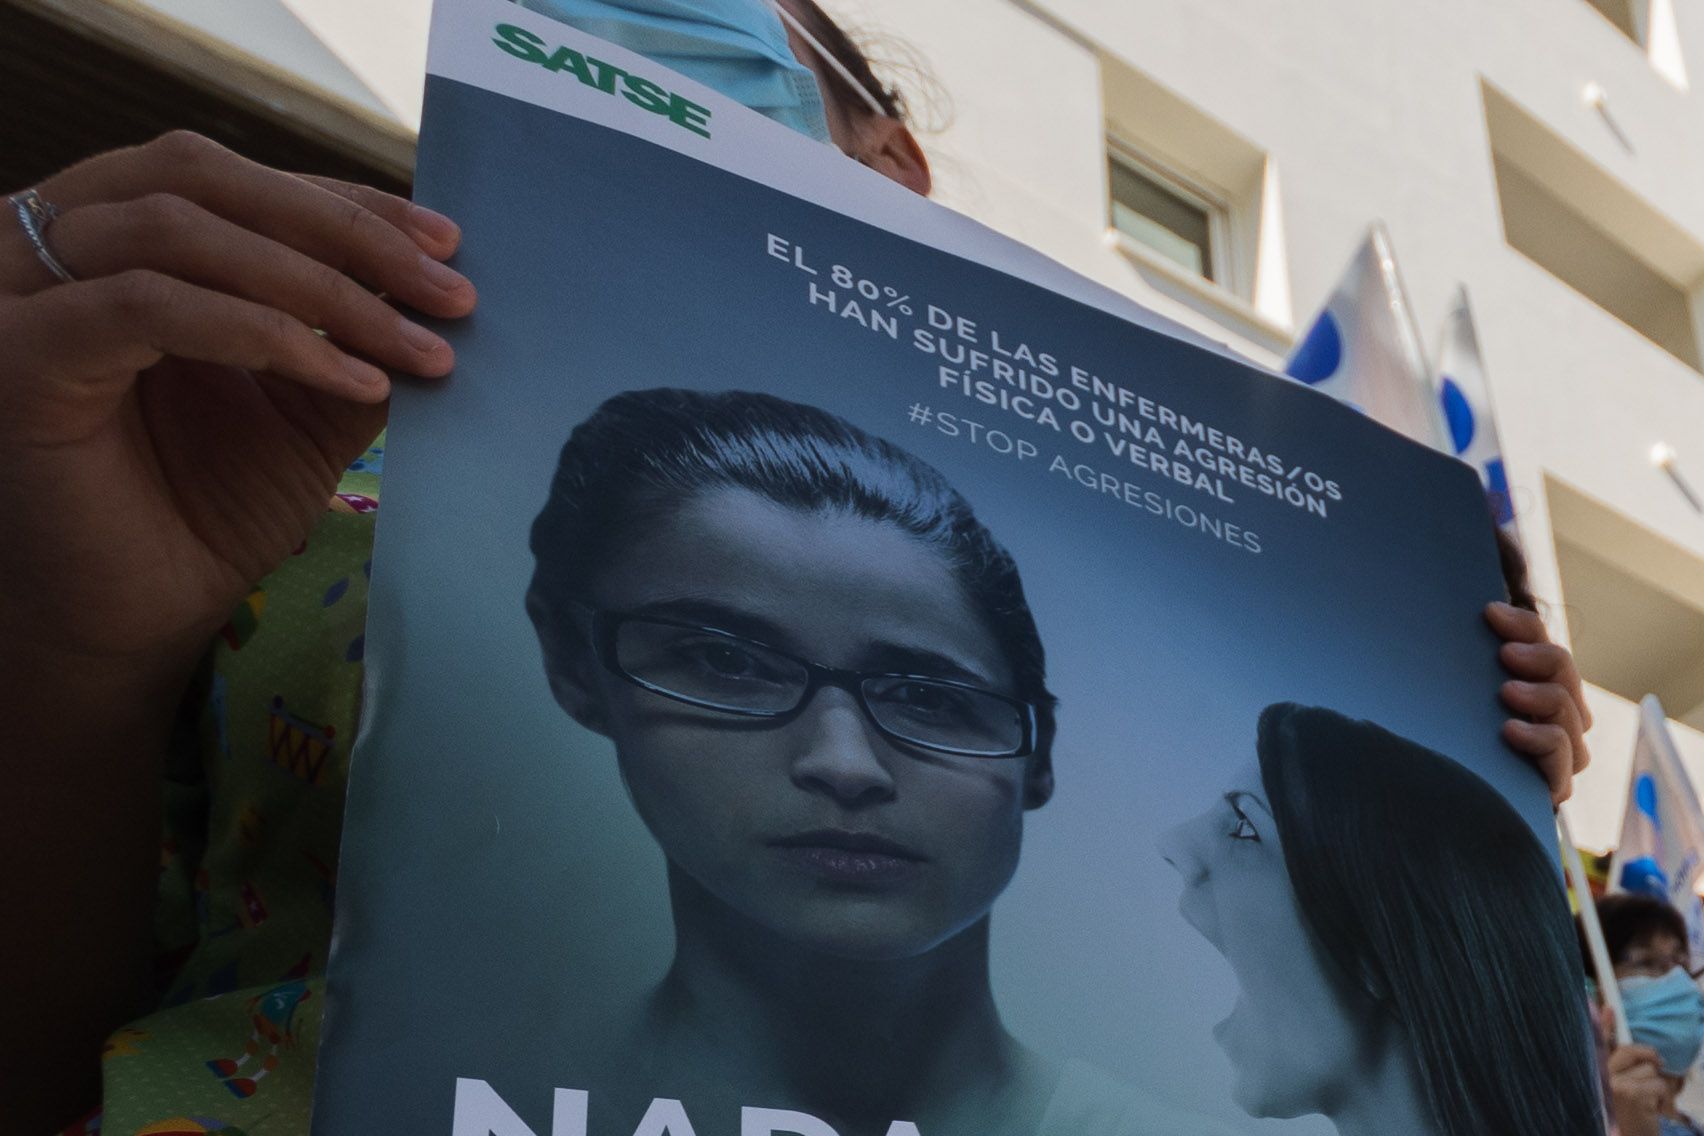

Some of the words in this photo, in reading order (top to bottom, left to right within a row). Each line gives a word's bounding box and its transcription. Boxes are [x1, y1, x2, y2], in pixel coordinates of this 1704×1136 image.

[491, 22, 712, 140] SATSE
[767, 233, 817, 275] EL
[831, 264, 913, 316] 80%
[928, 304, 977, 343] DE
[991, 330, 1059, 376] LAS
[1070, 366, 1343, 501] ENFERMERAS/OS
[809, 282, 898, 340] HAN
[913, 329, 1080, 411] SUFRIDO
[1092, 401, 1165, 449] UNA
[1173, 439, 1328, 518] AGRESIÓN
[939, 366, 1060, 432] FÍSICA
[1071, 421, 1095, 443] O
[1104, 433, 1235, 503] VERBAL
[907, 402, 1038, 461] #STOP
[1049, 455, 1262, 553] AGRESIONES
